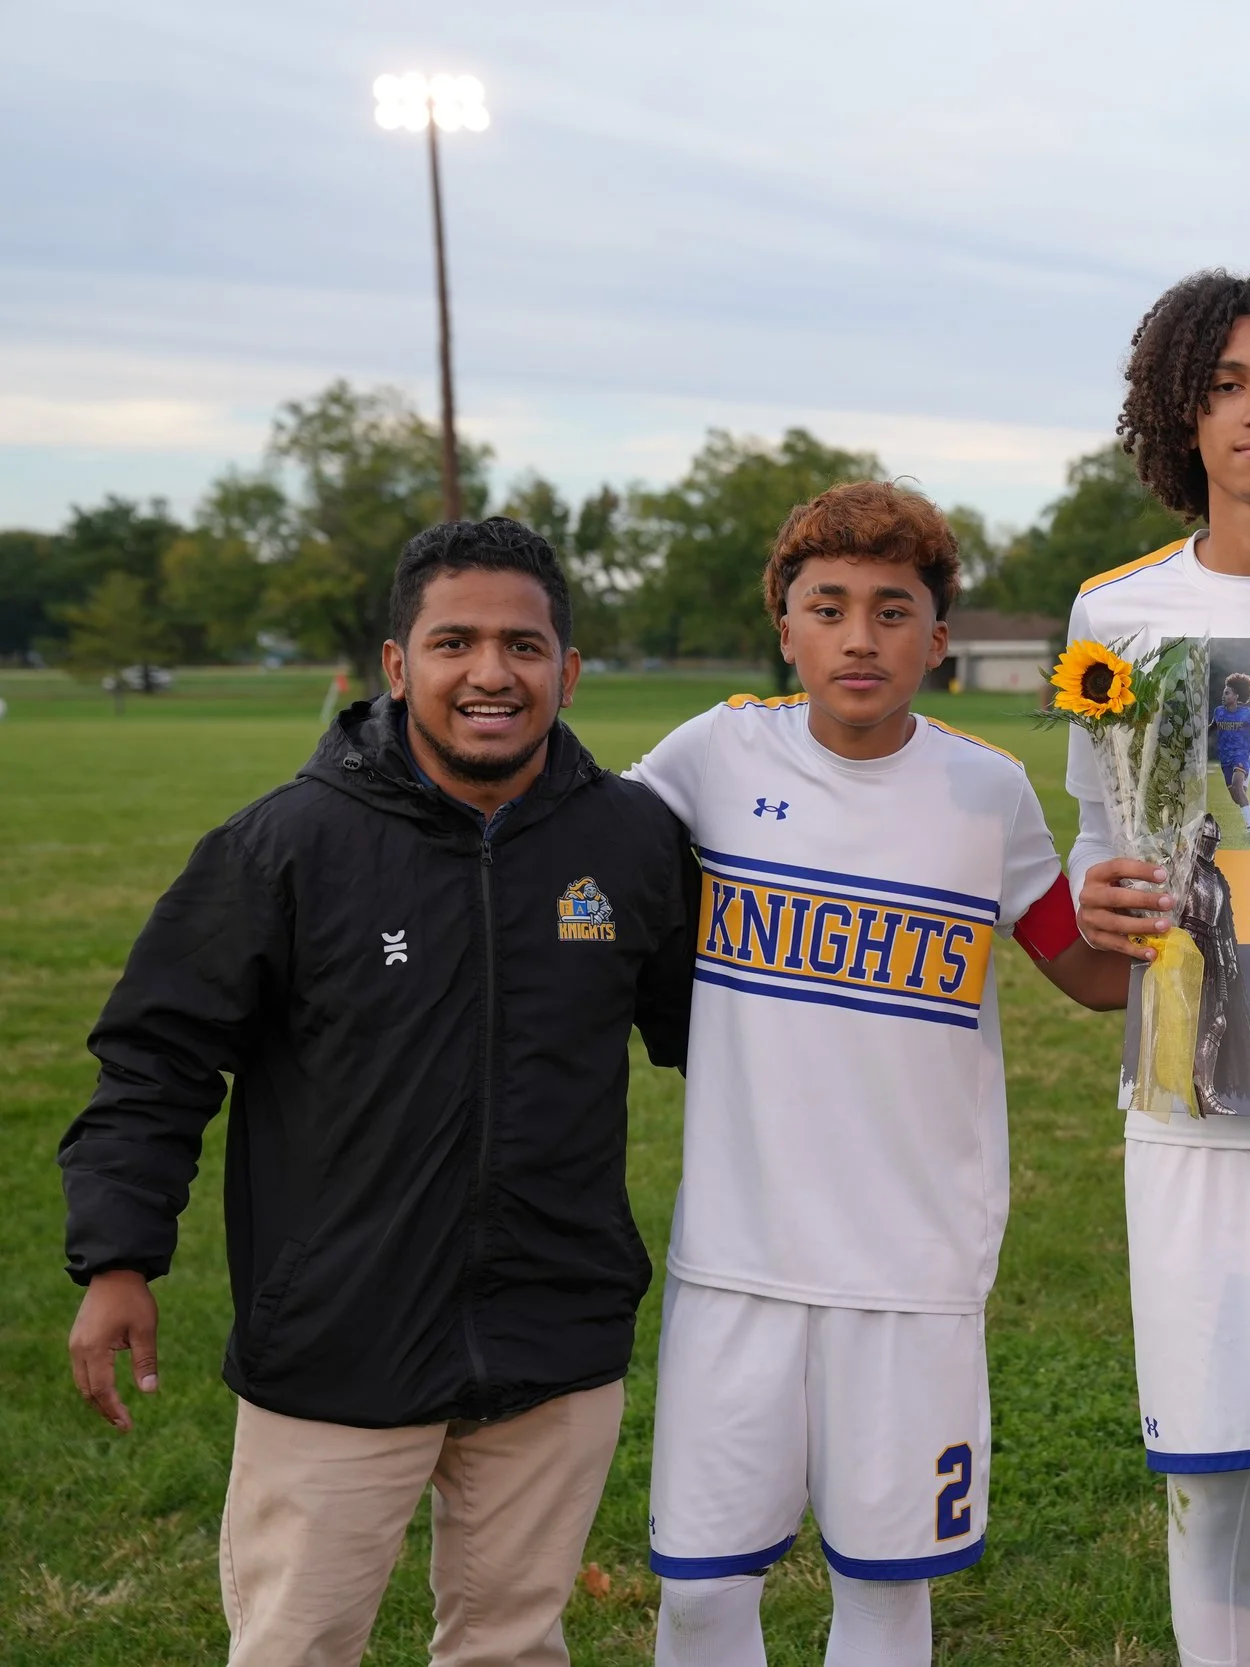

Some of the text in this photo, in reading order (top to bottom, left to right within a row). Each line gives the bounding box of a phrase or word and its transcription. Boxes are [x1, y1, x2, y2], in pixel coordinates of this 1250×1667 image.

[559, 922, 616, 940] KNIGHTS
[706, 880, 975, 994] KNIGHTS
[935, 1441, 972, 1542] 2
